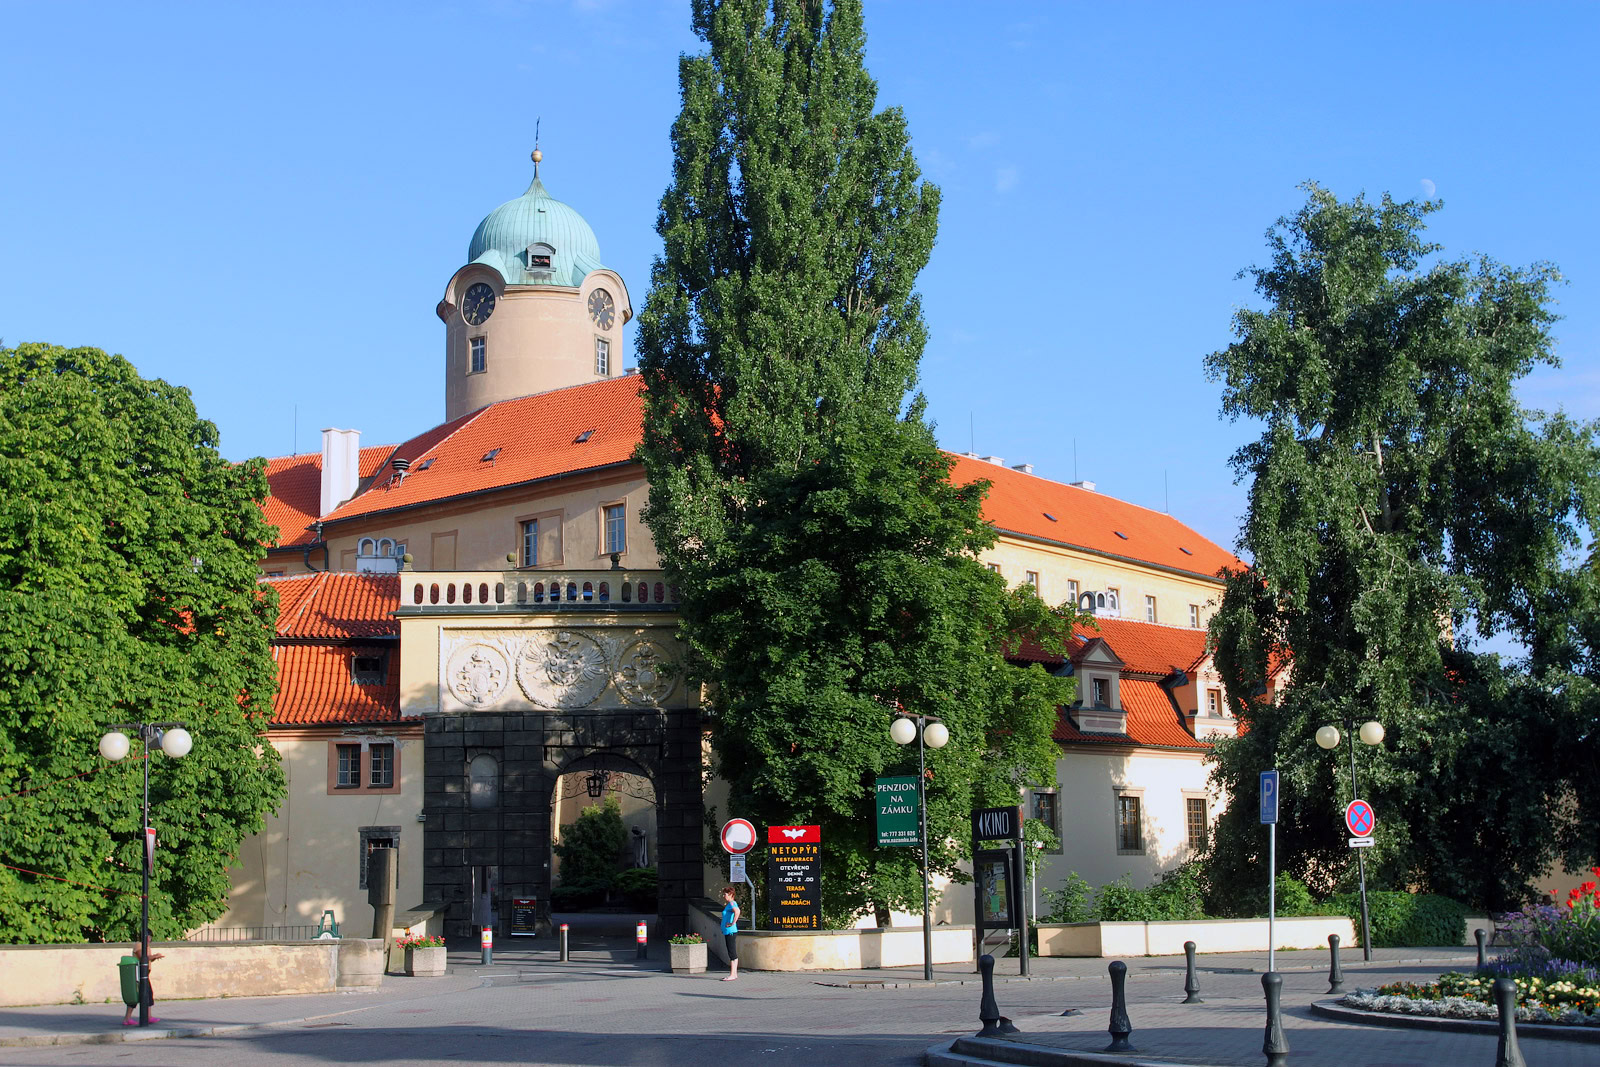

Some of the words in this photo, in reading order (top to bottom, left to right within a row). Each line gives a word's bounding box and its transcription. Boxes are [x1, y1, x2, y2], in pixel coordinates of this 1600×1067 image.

[877, 783, 915, 792] PENZION
[1263, 778, 1274, 808] P
[890, 795, 904, 803] NA
[881, 804, 913, 815] ZÁMKU
[984, 811, 1010, 836] KINO
[771, 845, 818, 854] NETOPÝR
